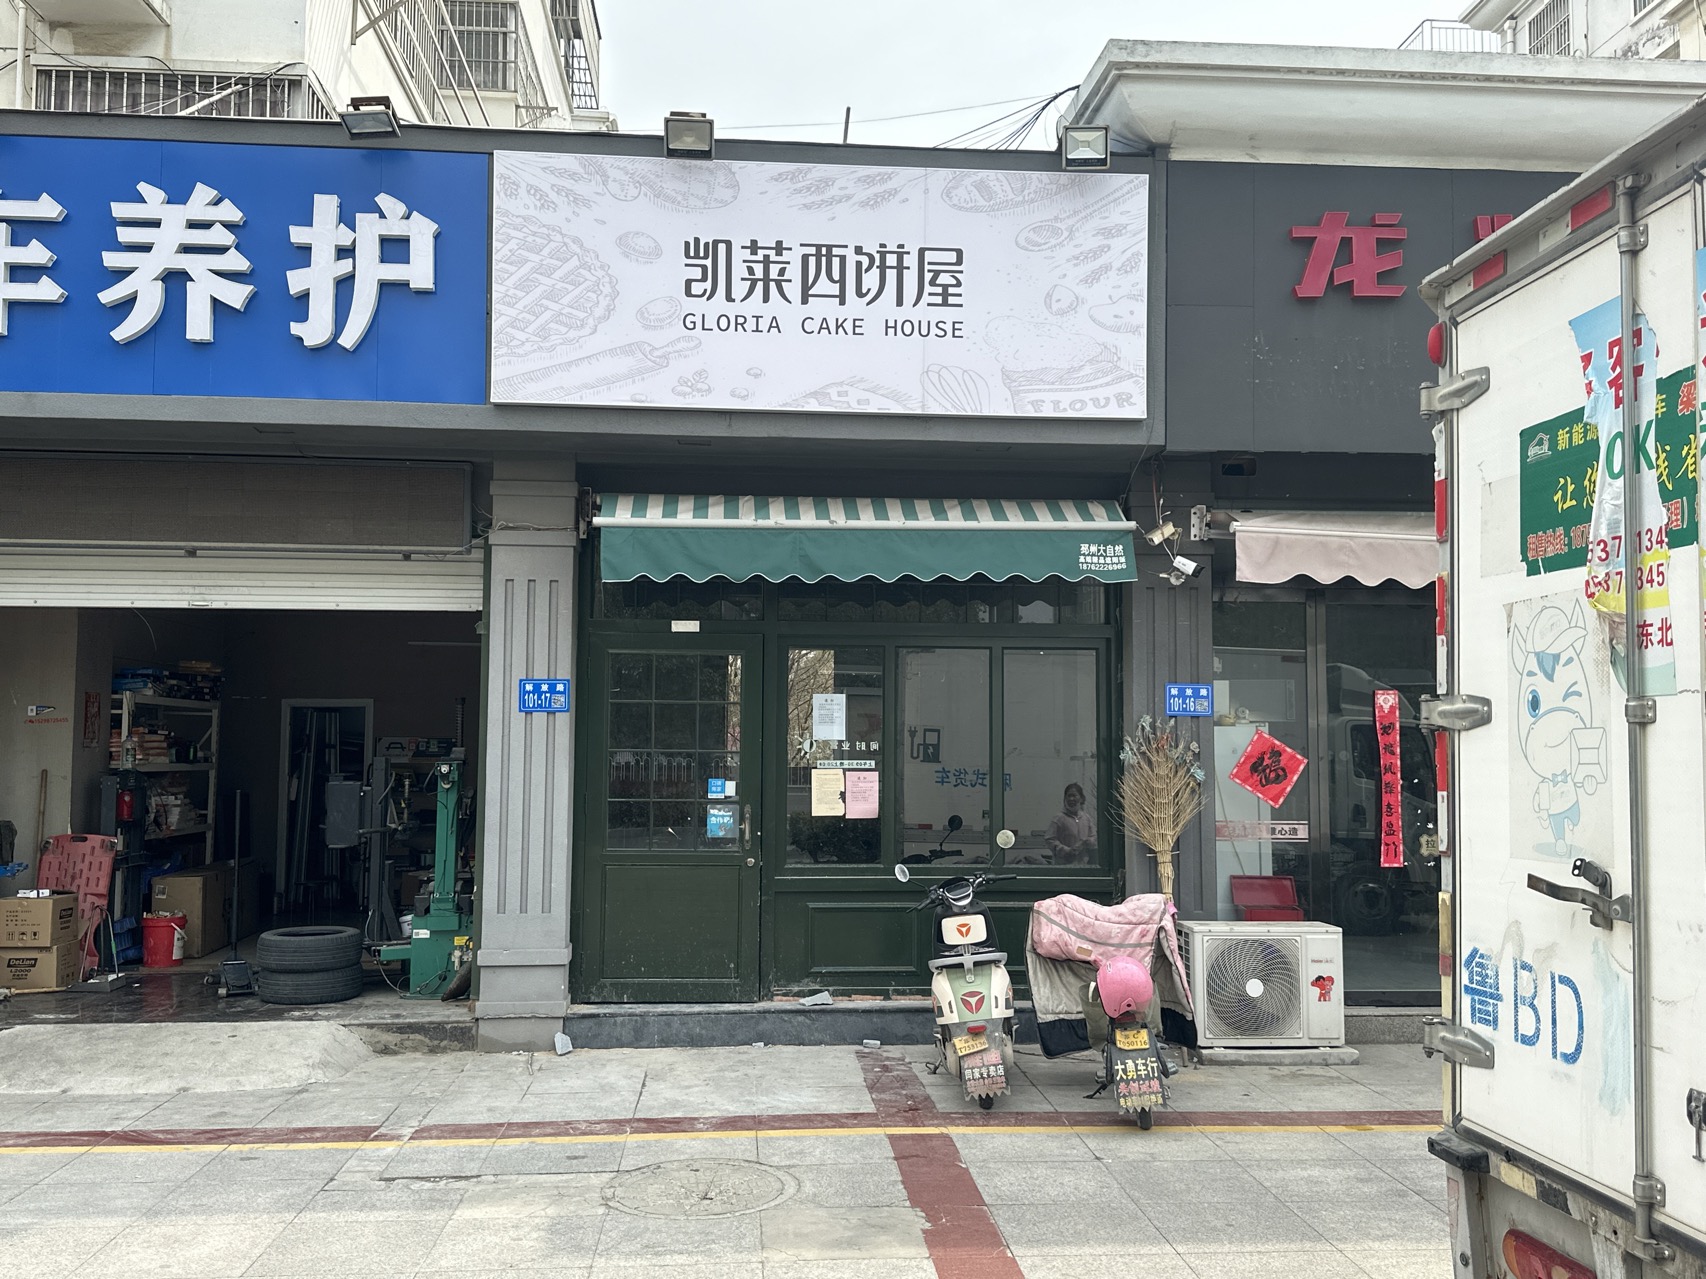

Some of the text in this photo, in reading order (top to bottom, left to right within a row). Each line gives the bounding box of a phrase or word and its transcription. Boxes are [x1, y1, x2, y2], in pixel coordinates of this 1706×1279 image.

[683, 237, 964, 309] 凯莱西饼屋
[682, 312, 965, 339] GLORIA CAKE HOUSE
[1027, 392, 1137, 413] FLOUR
[1080, 543, 1124, 556] 邳州大自然
[525, 683, 564, 692] 解放路
[1170, 687, 1208, 696] 解放路
[524, 693, 550, 708] 101-17
[1169, 698, 1195, 712] 101-16
[1114, 1057, 1158, 1081] 大勇车行
